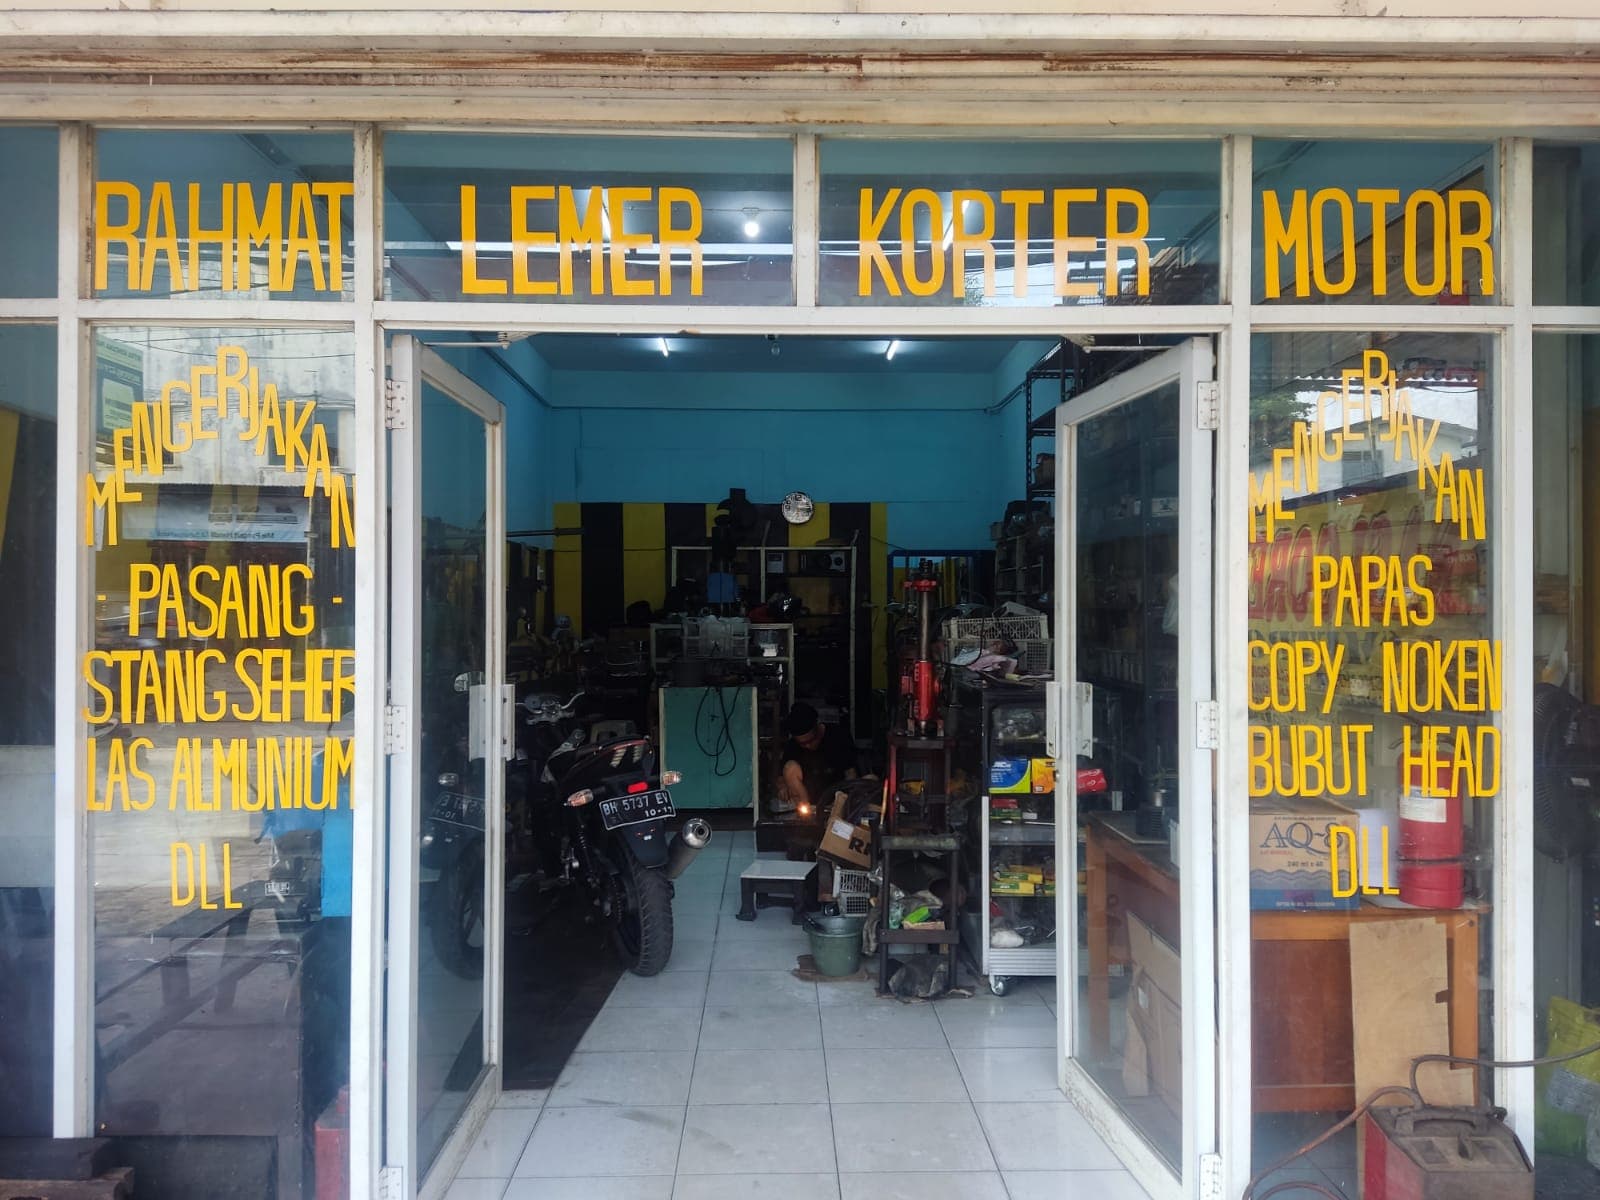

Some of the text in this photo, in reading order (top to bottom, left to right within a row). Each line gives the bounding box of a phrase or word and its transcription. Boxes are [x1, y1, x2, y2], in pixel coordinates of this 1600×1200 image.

[94, 182, 1494, 298] RAHMAT LEMER KORTER MOTOR
[85, 345, 356, 549] MENGERJAKAN
[1248, 349, 1487, 545] MENGERJAKAN
[128, 563, 315, 640] PASANG
[1311, 553, 1435, 629] PAPAS
[81, 648, 356, 724] STANG SEHER
[1248, 639, 1345, 714] COPY
[1383, 639, 1502, 713] NOKEN
[86, 735, 356, 812] LAS ALMUNIUM
[1248, 723, 1502, 798] BUBUT HEAD
[622, 795, 649, 811] 5737
[170, 842, 243, 909] DLL
[1329, 824, 1401, 898] DLL
